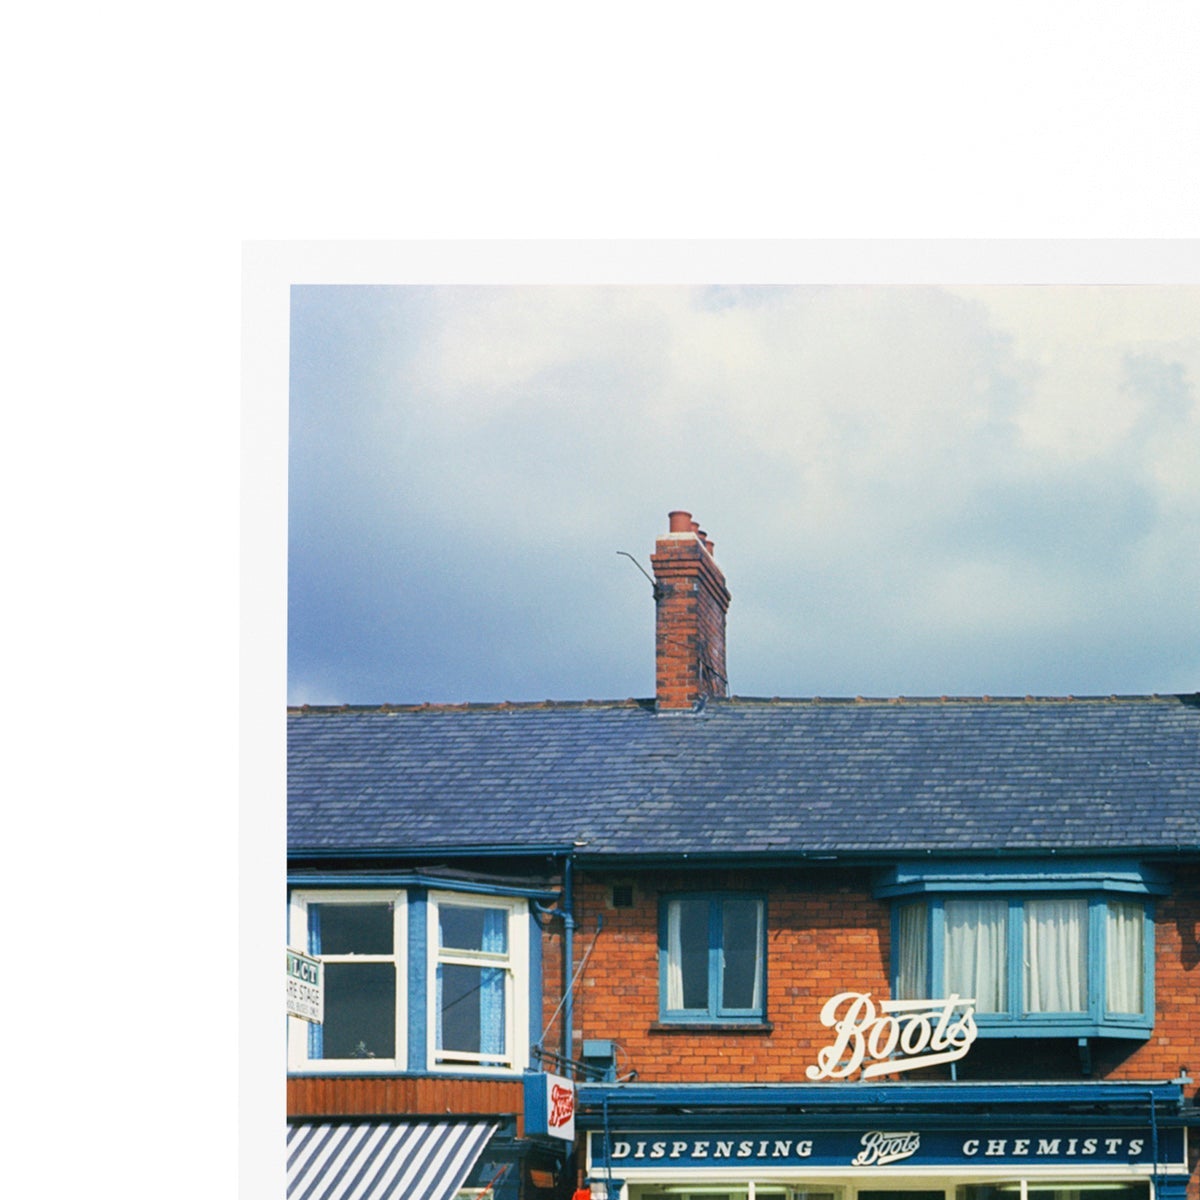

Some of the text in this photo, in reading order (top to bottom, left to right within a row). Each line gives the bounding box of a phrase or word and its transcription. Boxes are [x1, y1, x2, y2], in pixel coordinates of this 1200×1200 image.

[292, 959, 317, 983] LCT
[806, 992, 977, 1080] Boots
[611, 1131, 1144, 1166] DISPENSING Boots CHEMISTS
